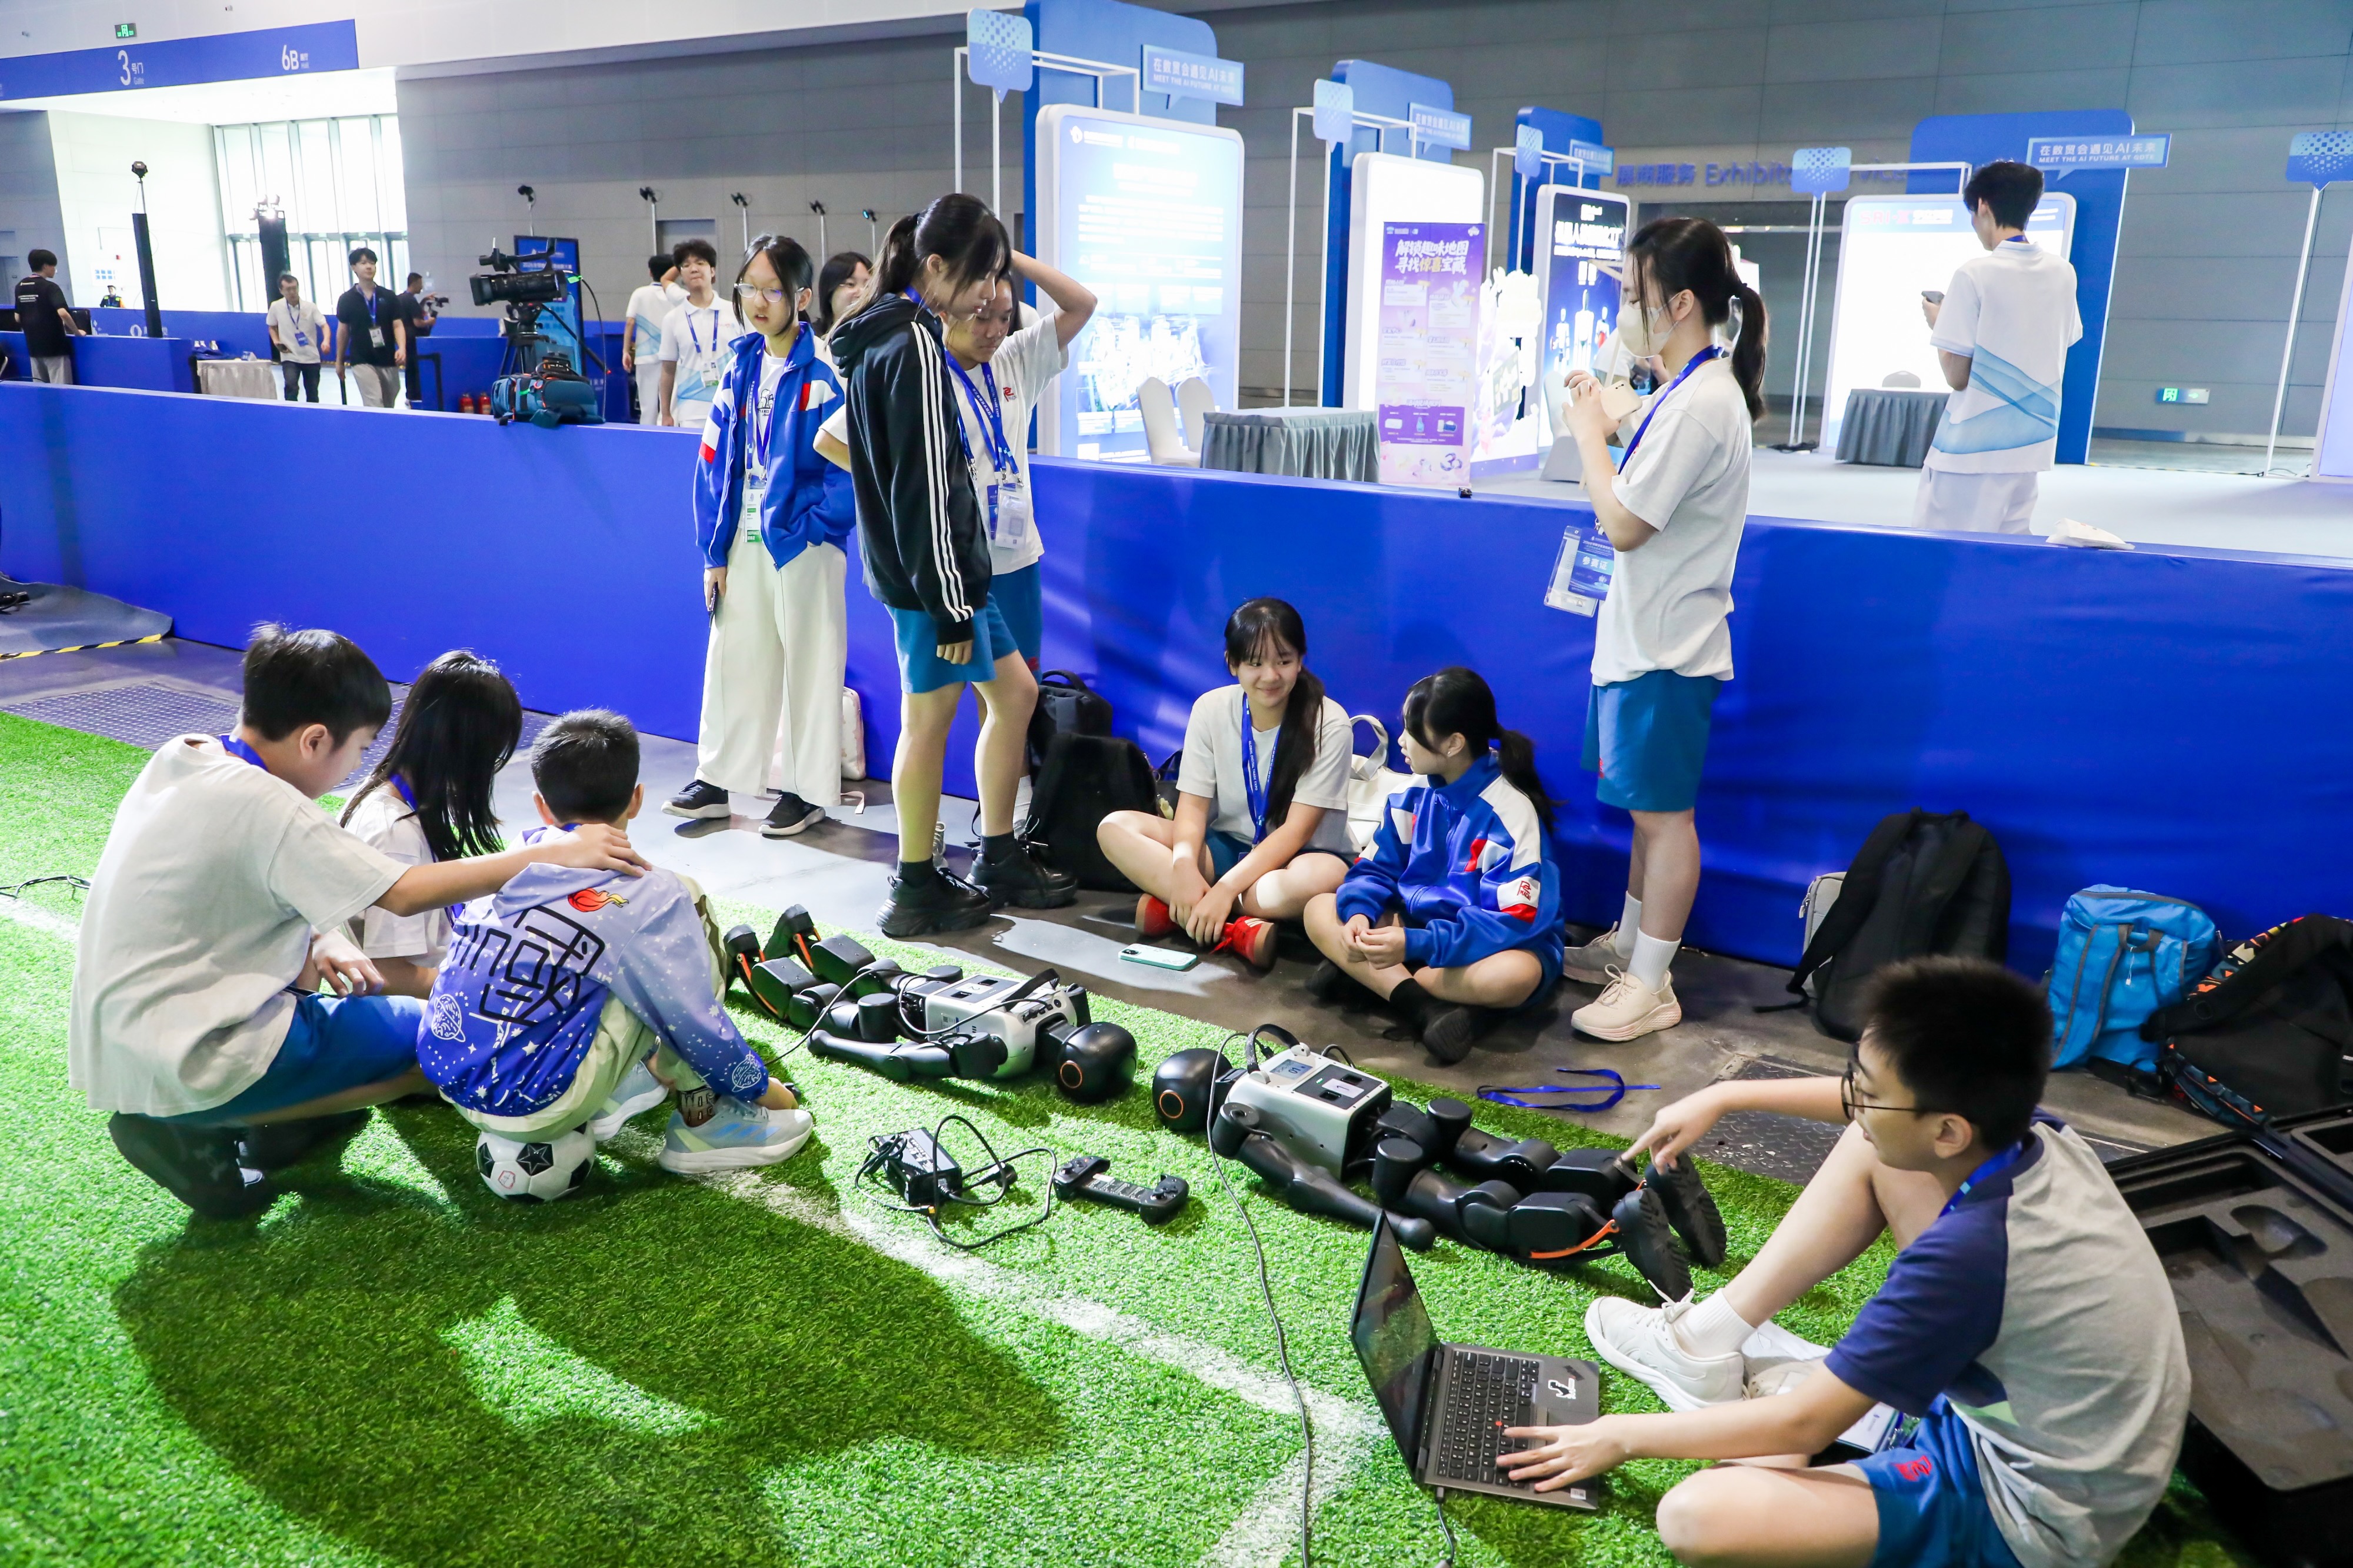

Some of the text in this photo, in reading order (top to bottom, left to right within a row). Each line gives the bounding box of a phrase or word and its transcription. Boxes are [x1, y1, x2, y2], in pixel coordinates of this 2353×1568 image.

[118, 49, 144, 86] 3 号门
[282, 44, 299, 71] 6B
[1617, 163, 1695, 186] 展商服务
[1395, 239, 1469, 258] 解锁趣味地图
[1395, 256, 1467, 275] 寻找惊喜宝藏
[1582, 556, 1608, 571] 参赛证
